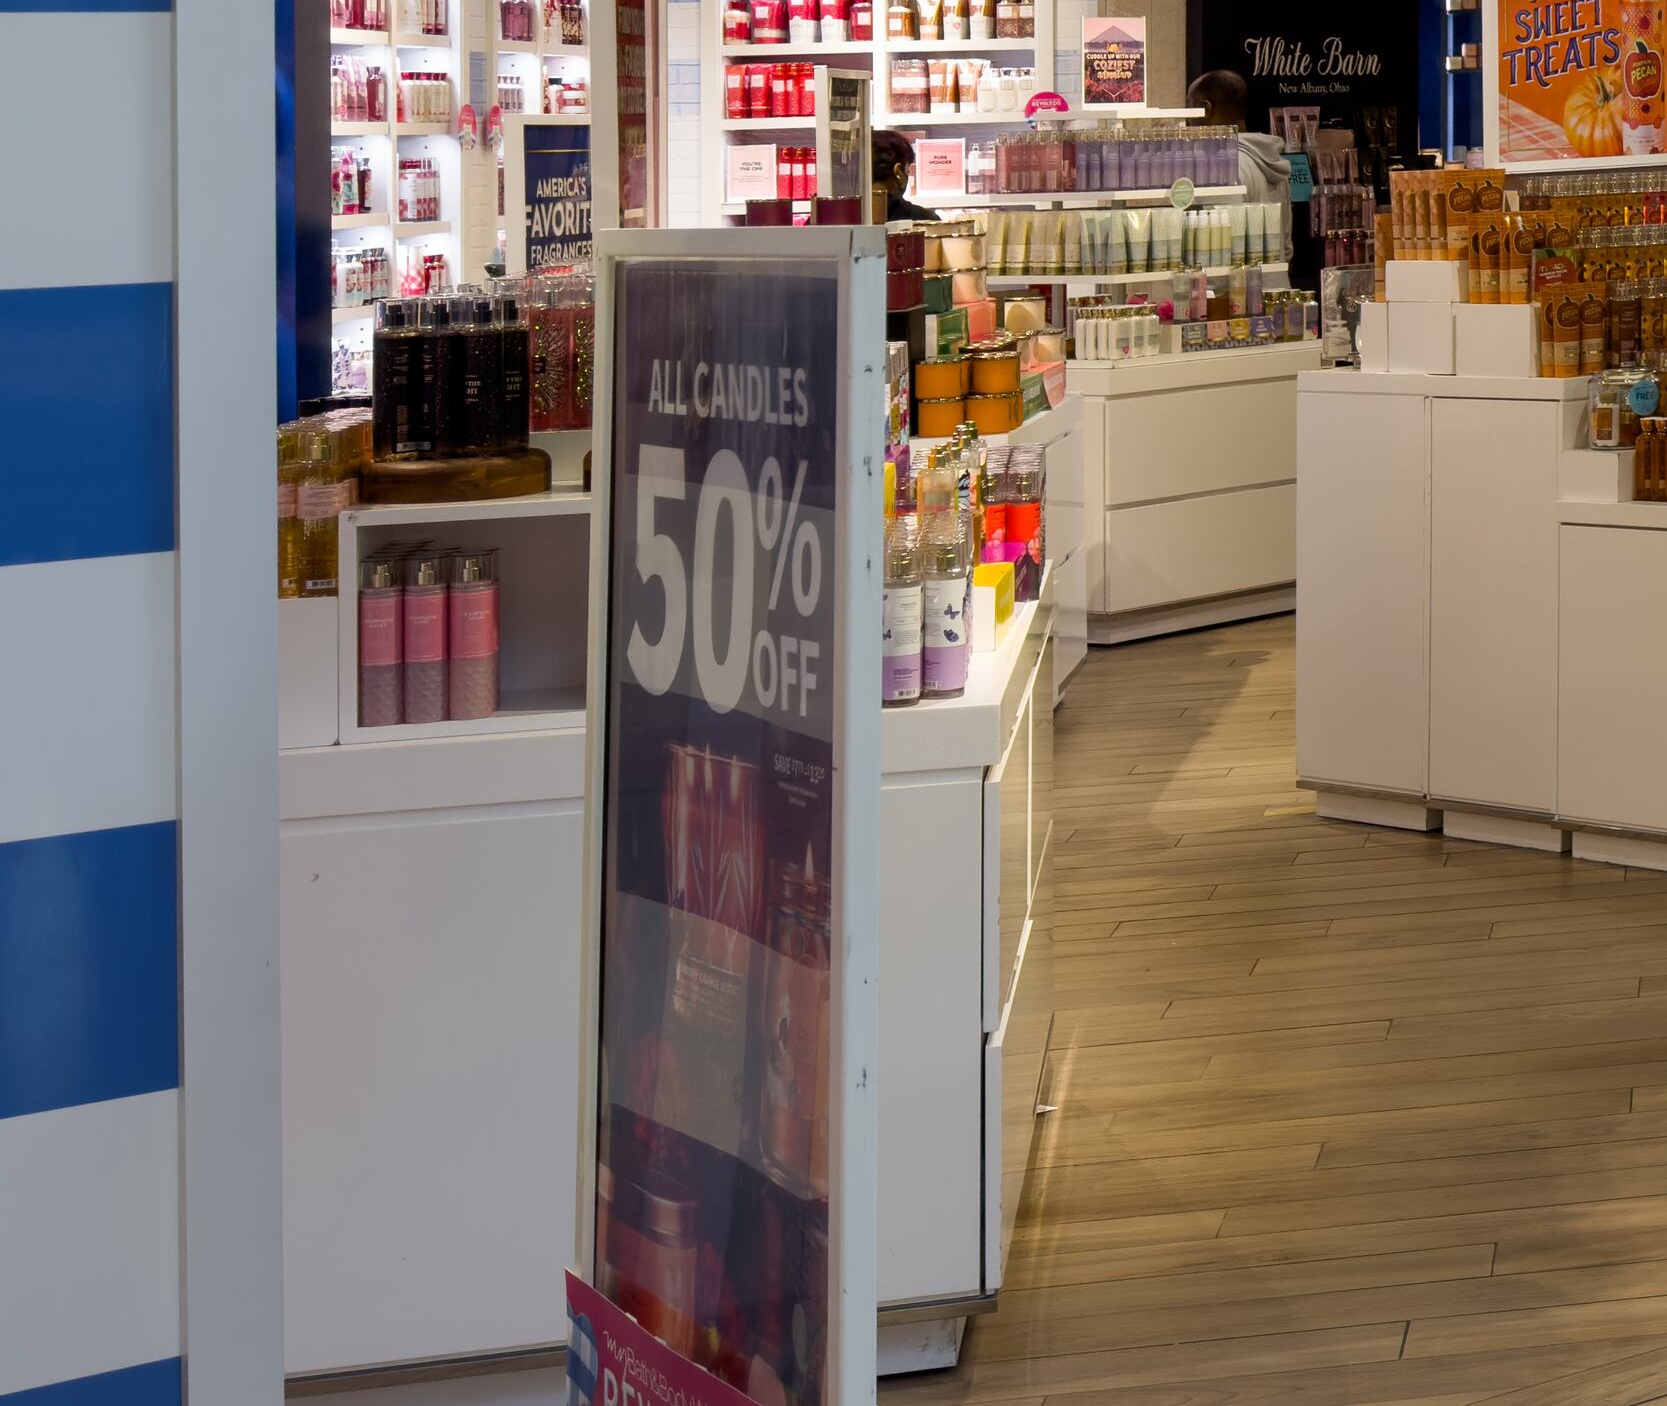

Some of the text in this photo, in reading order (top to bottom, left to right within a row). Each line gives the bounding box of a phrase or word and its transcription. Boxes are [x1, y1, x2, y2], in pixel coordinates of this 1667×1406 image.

[1093, 60, 1136, 71] COZIEST
[1244, 36, 1382, 76] White Barn
[1503, 28, 1622, 90] TREATS
[1631, 64, 1657, 85] PECAN
[1279, 83, 1298, 93] New
[1329, 82, 1350, 93] Ohio
[536, 177, 587, 198] AMERICA'S
[526, 201, 592, 238] FAVORIT
[531, 240, 592, 267] FRAGRANCES
[647, 358, 809, 428] ALL CANDLES
[627, 448, 822, 715] 50%
[753, 629, 820, 717] OFF
